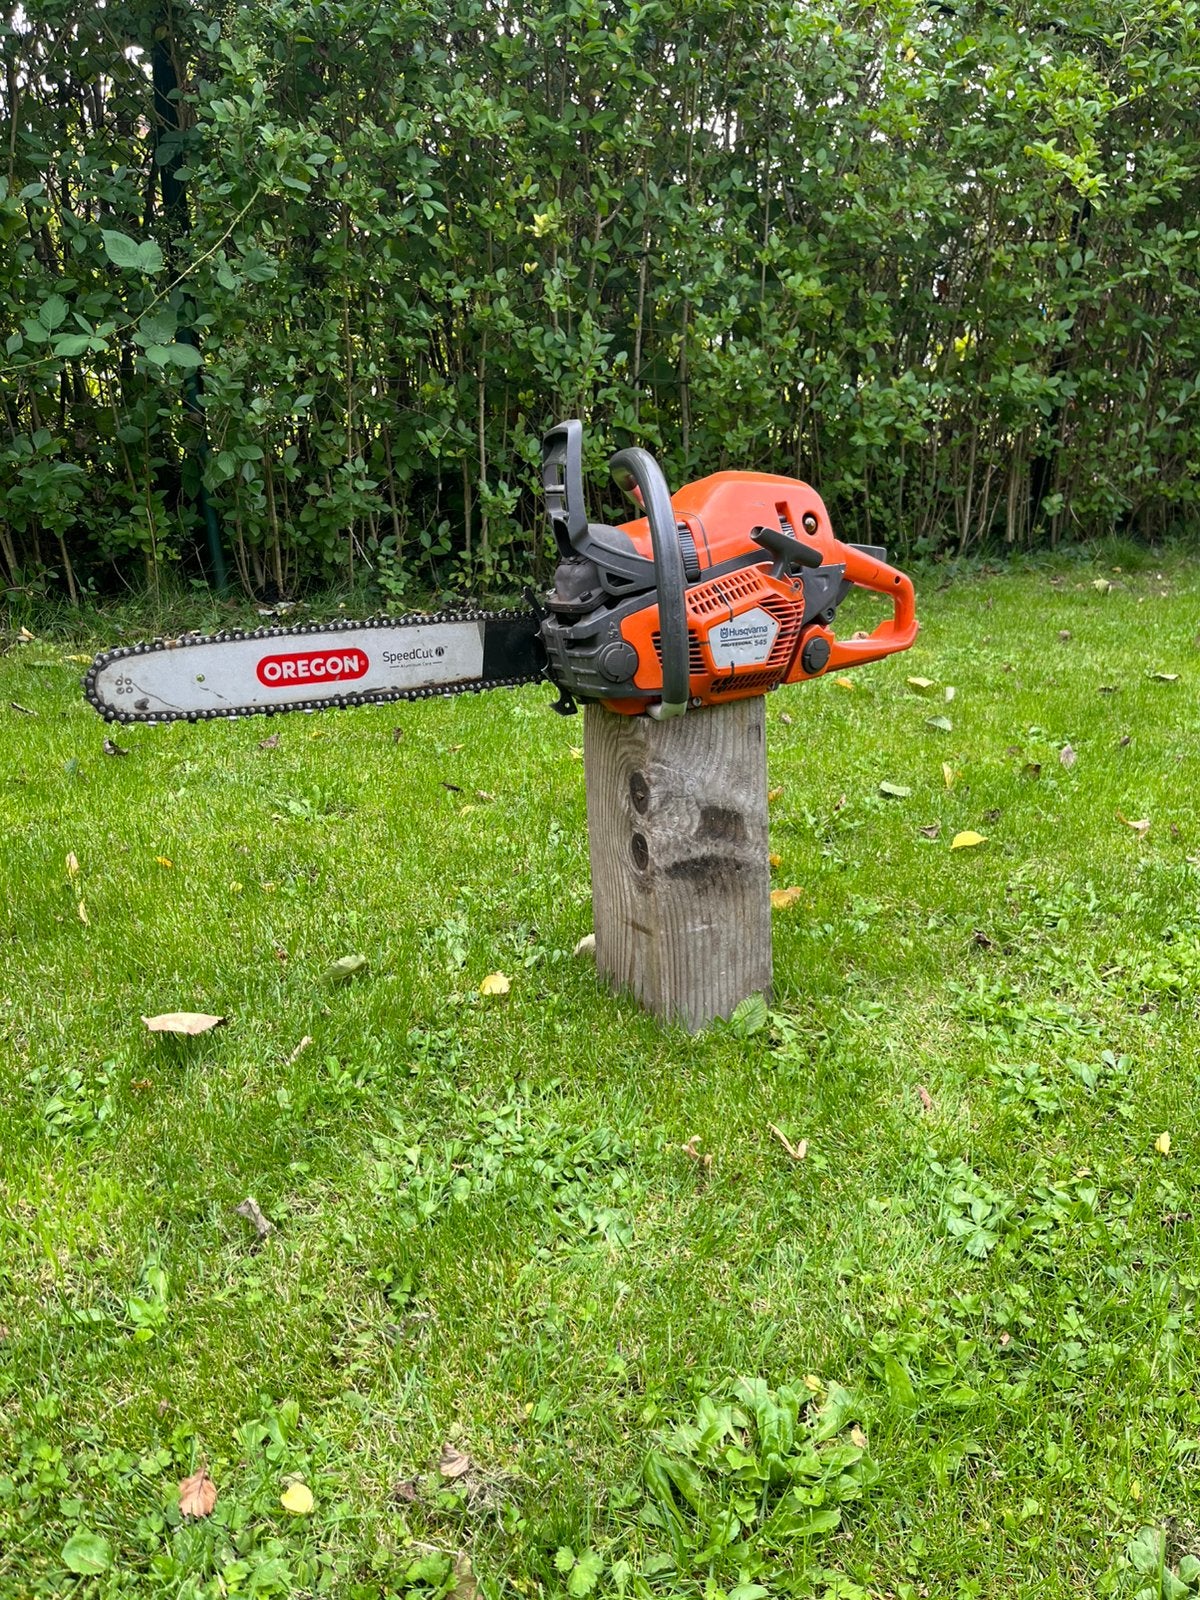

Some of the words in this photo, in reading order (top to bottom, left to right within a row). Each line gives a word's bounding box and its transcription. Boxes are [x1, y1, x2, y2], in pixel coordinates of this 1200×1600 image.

[729, 626, 768, 637] Husqvarna
[382, 648, 434, 664] SpeedCut
[263, 654, 360, 681] OREGON
